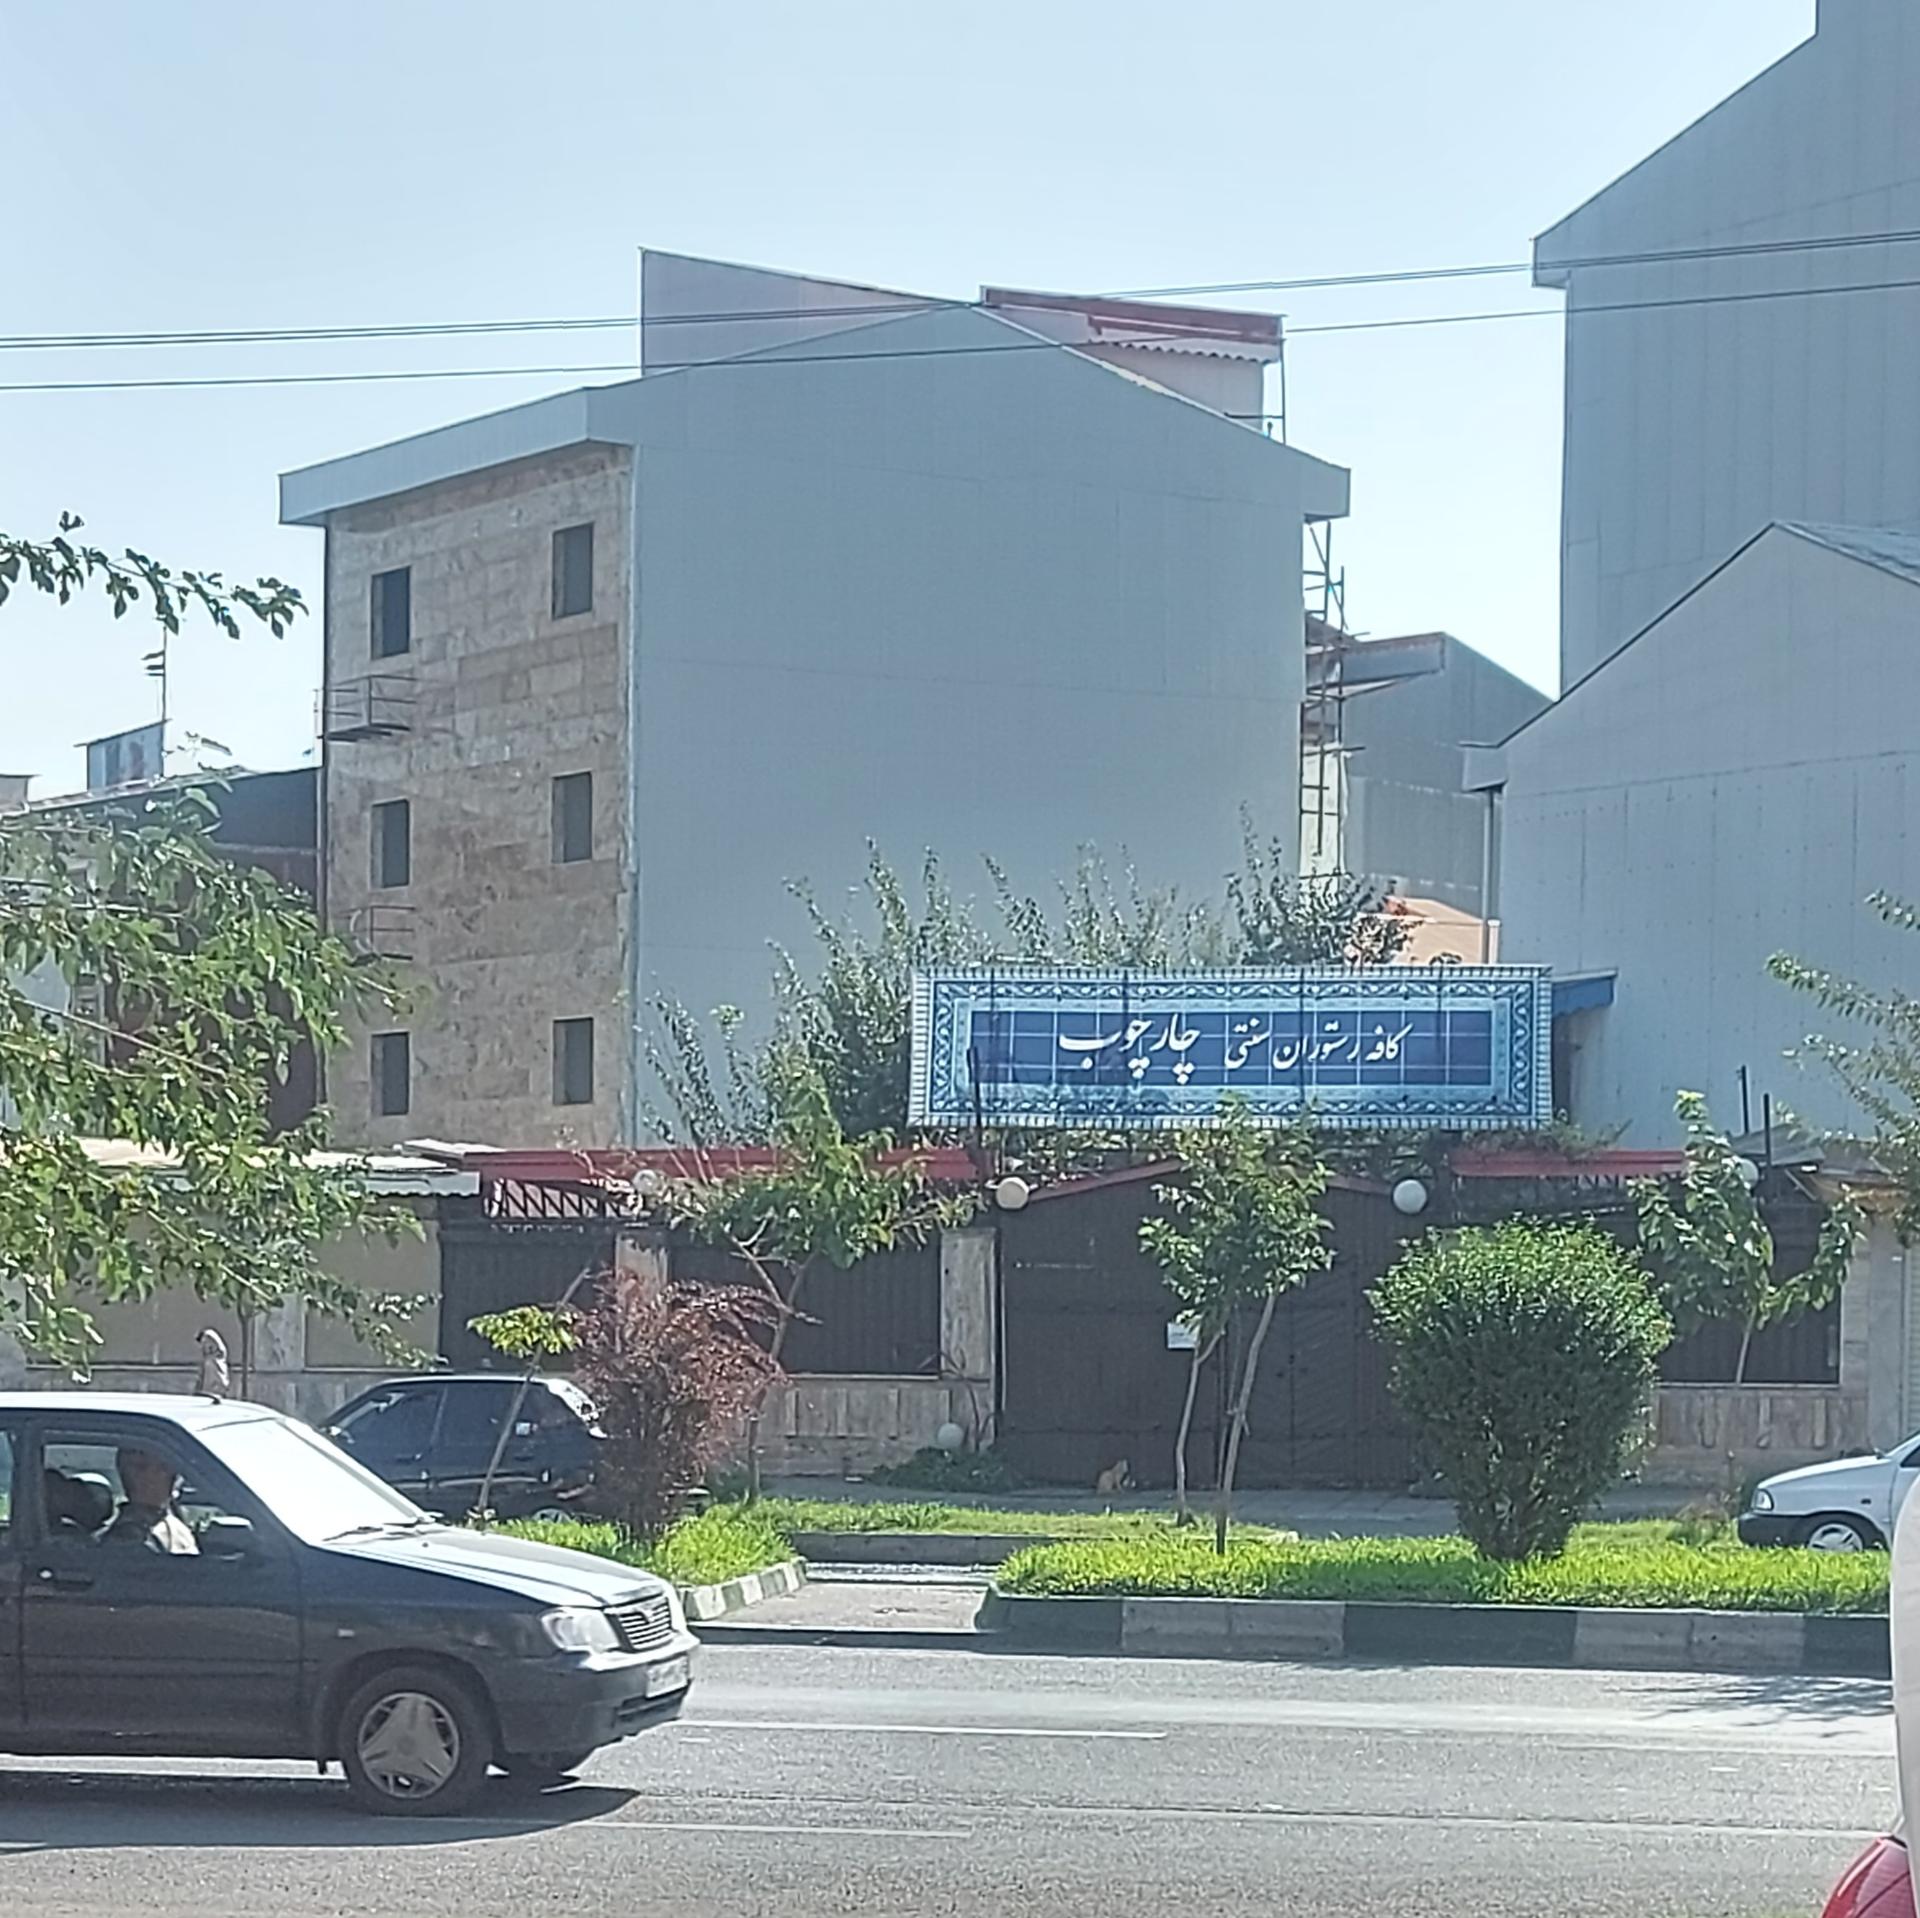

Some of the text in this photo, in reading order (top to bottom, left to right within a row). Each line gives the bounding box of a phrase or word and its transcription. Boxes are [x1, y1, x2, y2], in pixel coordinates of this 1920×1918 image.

[1224, 1017, 1272, 1070] سنتی
[1272, 1020, 1360, 1070] رستوران
[1365, 1022, 1413, 1061] کافه
